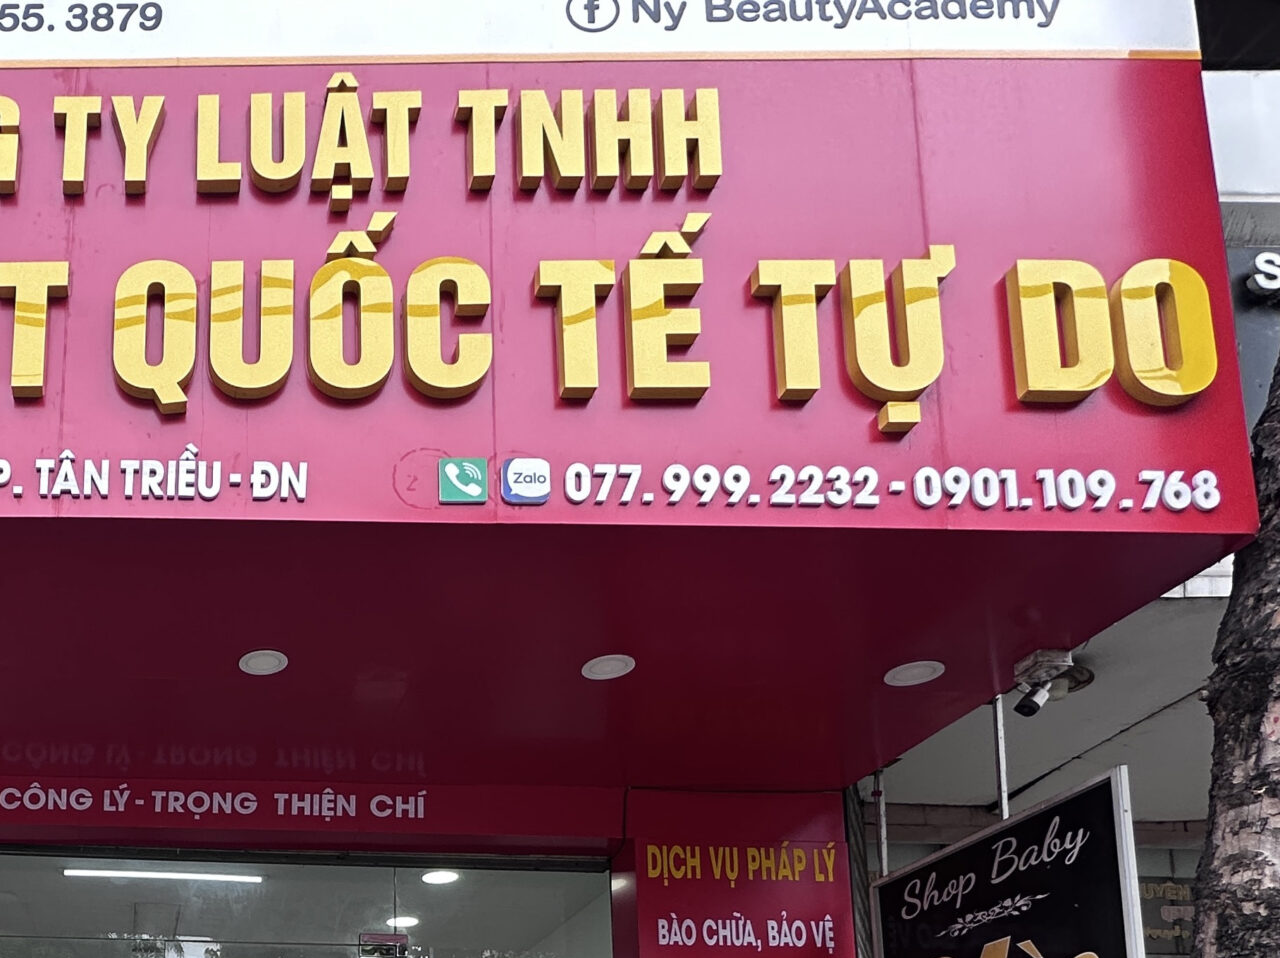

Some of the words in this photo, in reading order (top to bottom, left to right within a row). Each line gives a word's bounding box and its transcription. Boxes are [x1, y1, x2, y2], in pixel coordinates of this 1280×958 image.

[632, 0, 687, 31] Ny
[54, 95, 164, 195] TY
[196, 72, 422, 213] LUẬT
[455, 88, 722, 191] TNHH
[112, 212, 493, 415] QUỐC
[533, 212, 711, 400] TẾ
[750, 244, 956, 432] TỰ
[1000, 258, 1217, 407] DO
[35, 449, 108, 499] TÂN
[120, 442, 221, 500] TRIỀU
[250, 460, 308, 501] ĐN
[513, 472, 547, 484] Zalo
[152, 790, 258, 820] TRỌNG
[274, 788, 356, 822] THIỆN
[369, 790, 428, 819] CHÍ
[646, 845, 701, 886] DỊCH
[709, 847, 739, 888] VỤ
[747, 840, 807, 880] PHÁP
[814, 842, 836, 882] LÝ
[901, 872, 975, 920] Shop
[990, 815, 1091, 886] Baby
[658, 912, 697, 945] BÀO
[767, 910, 807, 947] BẢO
[810, 914, 835, 954] VỆ
